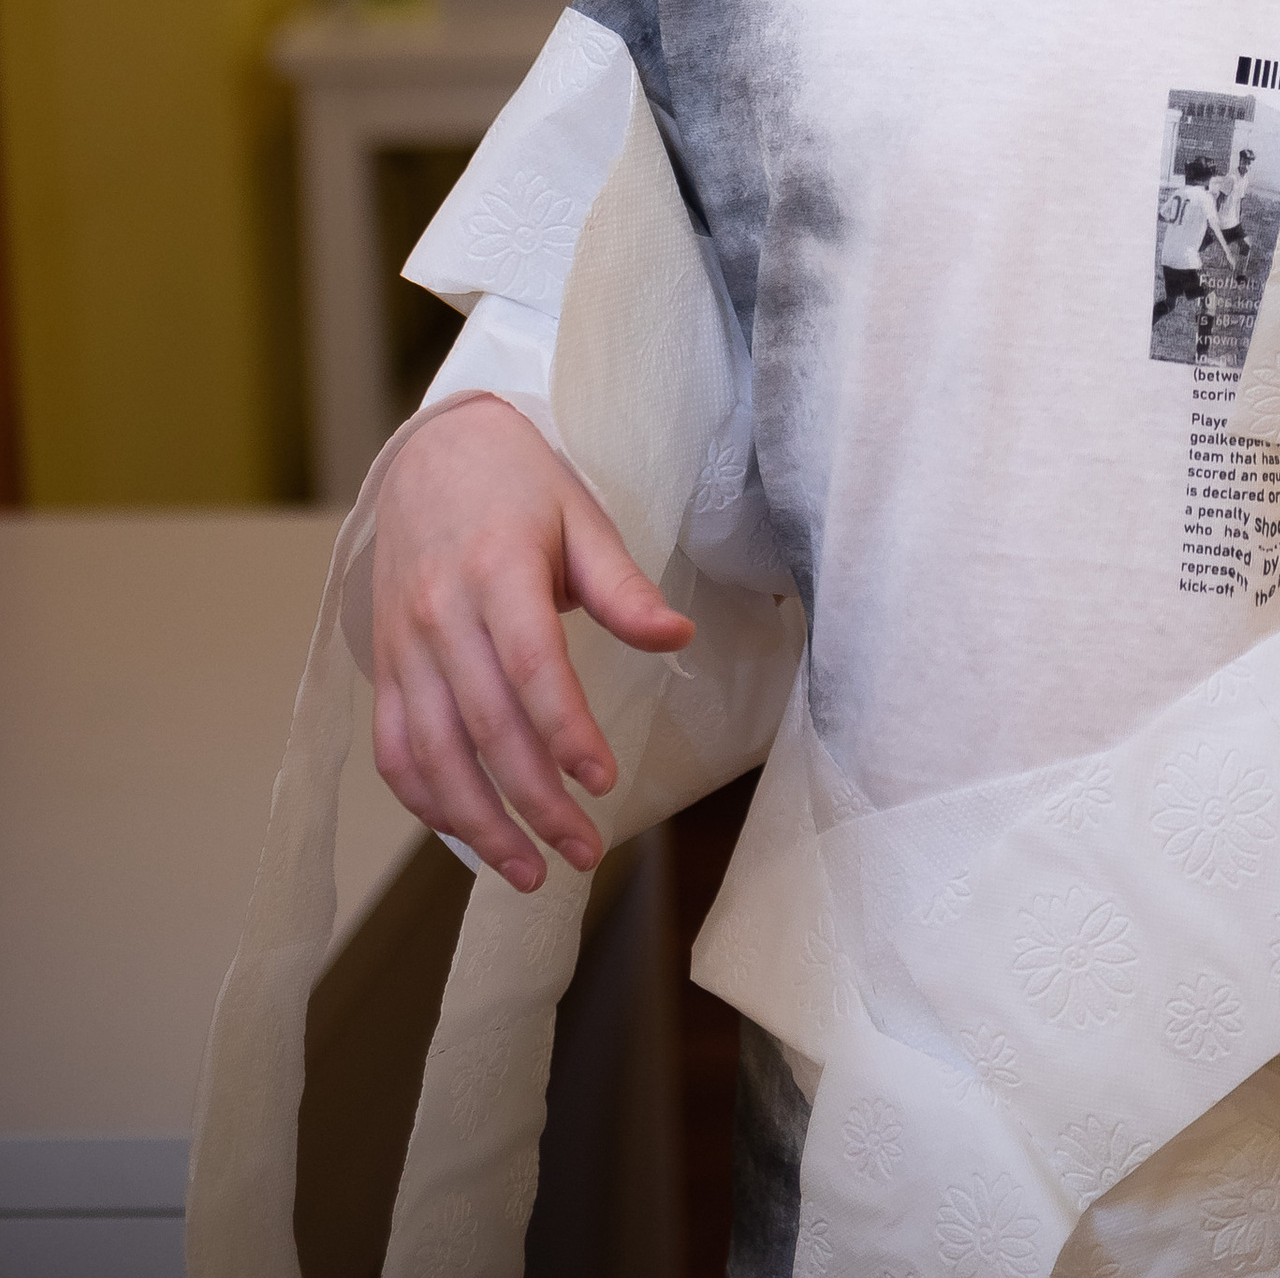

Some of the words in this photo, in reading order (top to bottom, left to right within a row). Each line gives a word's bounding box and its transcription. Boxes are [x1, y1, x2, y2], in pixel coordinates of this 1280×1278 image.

[1189, 448, 1224, 464] team
[1230, 451, 1257, 464] that
[1262, 452, 1280, 465] has
[1187, 467, 1236, 481] scored
[1241, 471, 1258, 482] an
[1186, 483, 1197, 497] is
[1202, 486, 1264, 502] declared
[1268, 490, 1280, 503] or
[1185, 505, 1193, 516] a
[1198, 506, 1250, 526] penalty
[1184, 523, 1212, 536] who
[1224, 524, 1249, 540] has
[1182, 543, 1252, 566] mandated
[1263, 555, 1279, 576] by
[1181, 561, 1248, 592] represent
[1179, 578, 1234, 598] kick-off
